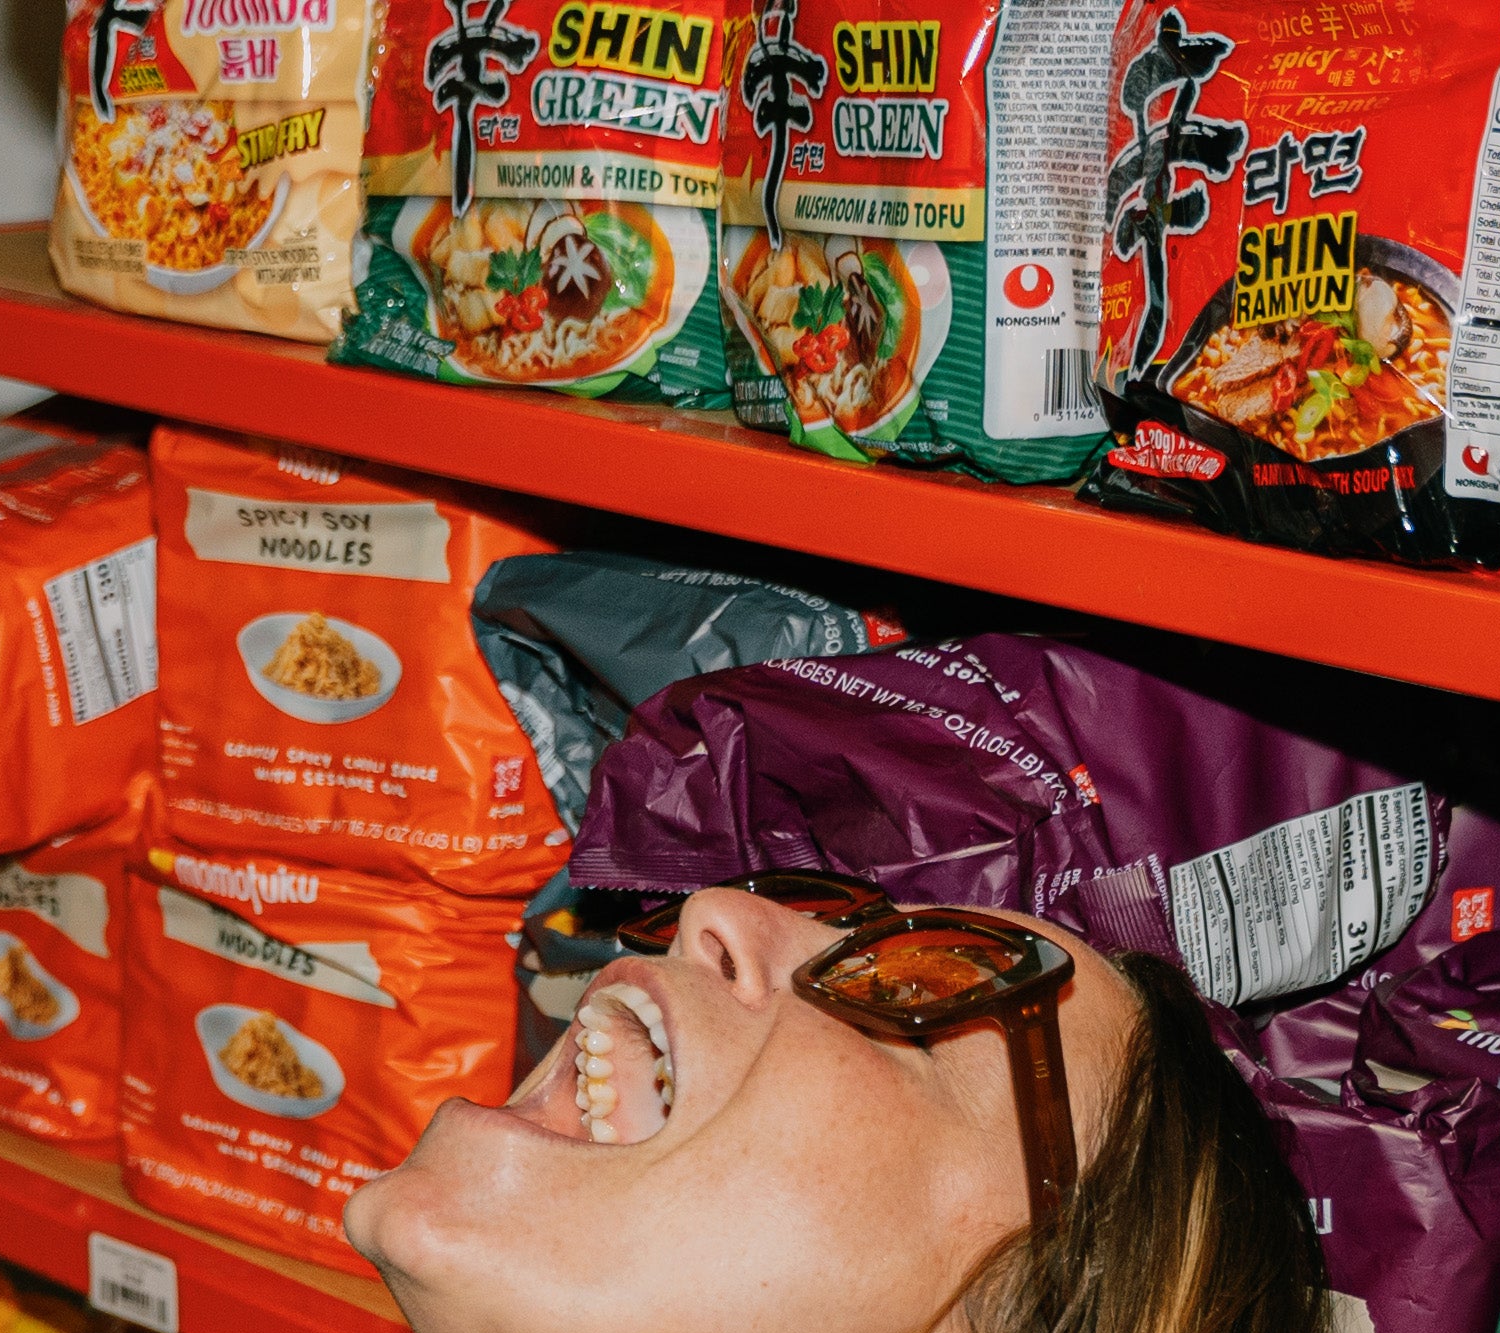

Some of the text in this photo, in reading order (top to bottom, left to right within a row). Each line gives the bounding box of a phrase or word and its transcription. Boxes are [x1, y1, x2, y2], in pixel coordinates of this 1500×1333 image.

[216, 36, 280, 84] 툼바
[551, 6, 711, 82] SHIN
[836, 24, 938, 90] SHIN
[276, 107, 326, 157] FRY
[478, 112, 520, 144] 라면
[532, 71, 721, 143] GREEN
[833, 99, 948, 160] GREEN
[496, 163, 663, 193] MUSHROOM & FRIED
[791, 142, 826, 175] 라면
[1241, 125, 1367, 215] 라면
[794, 194, 965, 230] MUSHROOM FRIED TOFU
[1237, 213, 1356, 288] SHIN
[995, 315, 1062, 328] NONGSHIM
[1235, 273, 1353, 325] RAMYUN
[1464, 301, 1496, 317] Protein
[1455, 346, 1488, 361] Calcium
[237, 507, 372, 533] SPICY SOY
[259, 536, 375, 567] NOODLES
[896, 647, 938, 671] RICH
[836, 670, 1045, 778] NET WT OZ (1.05 LB)
[1342, 803, 1356, 893] Calories
[1408, 786, 1430, 888] Nutrition
[173, 854, 320, 915] momofuku
